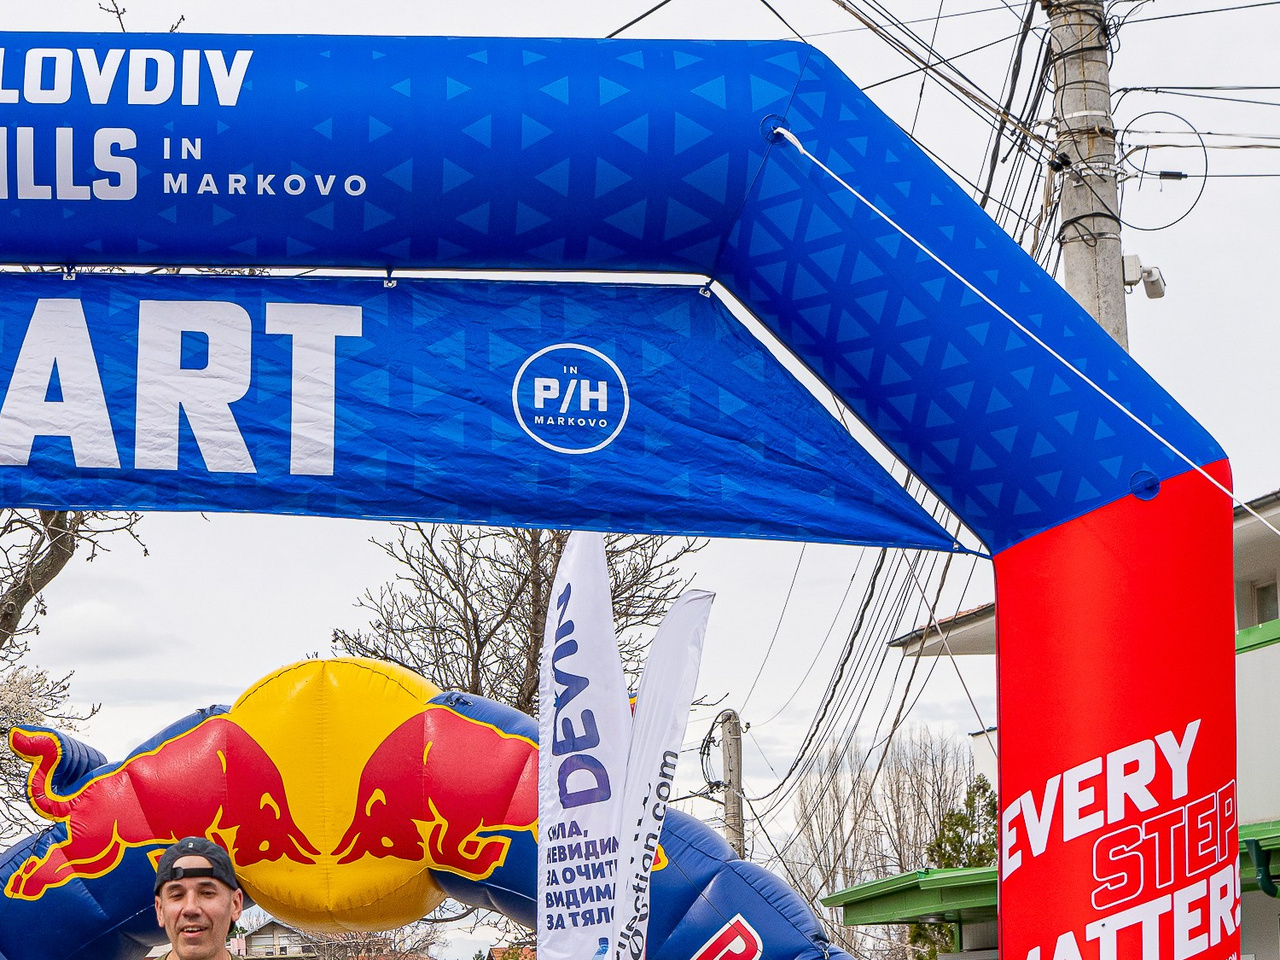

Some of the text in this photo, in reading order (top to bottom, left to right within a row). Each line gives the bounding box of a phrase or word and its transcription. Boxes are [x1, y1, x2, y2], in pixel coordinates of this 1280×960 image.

[163, 138, 202, 160] IN
[162, 173, 367, 196] MARKOVO
[563, 365, 578, 375] IN
[534, 377, 608, 413] P/H
[534, 416, 608, 428] MARKOVO
[1002, 718, 1202, 882] EVERY
[1091, 778, 1237, 911] STEP
[545, 883, 616, 909] ВИДИМ
[546, 913, 566, 930] ЗА
